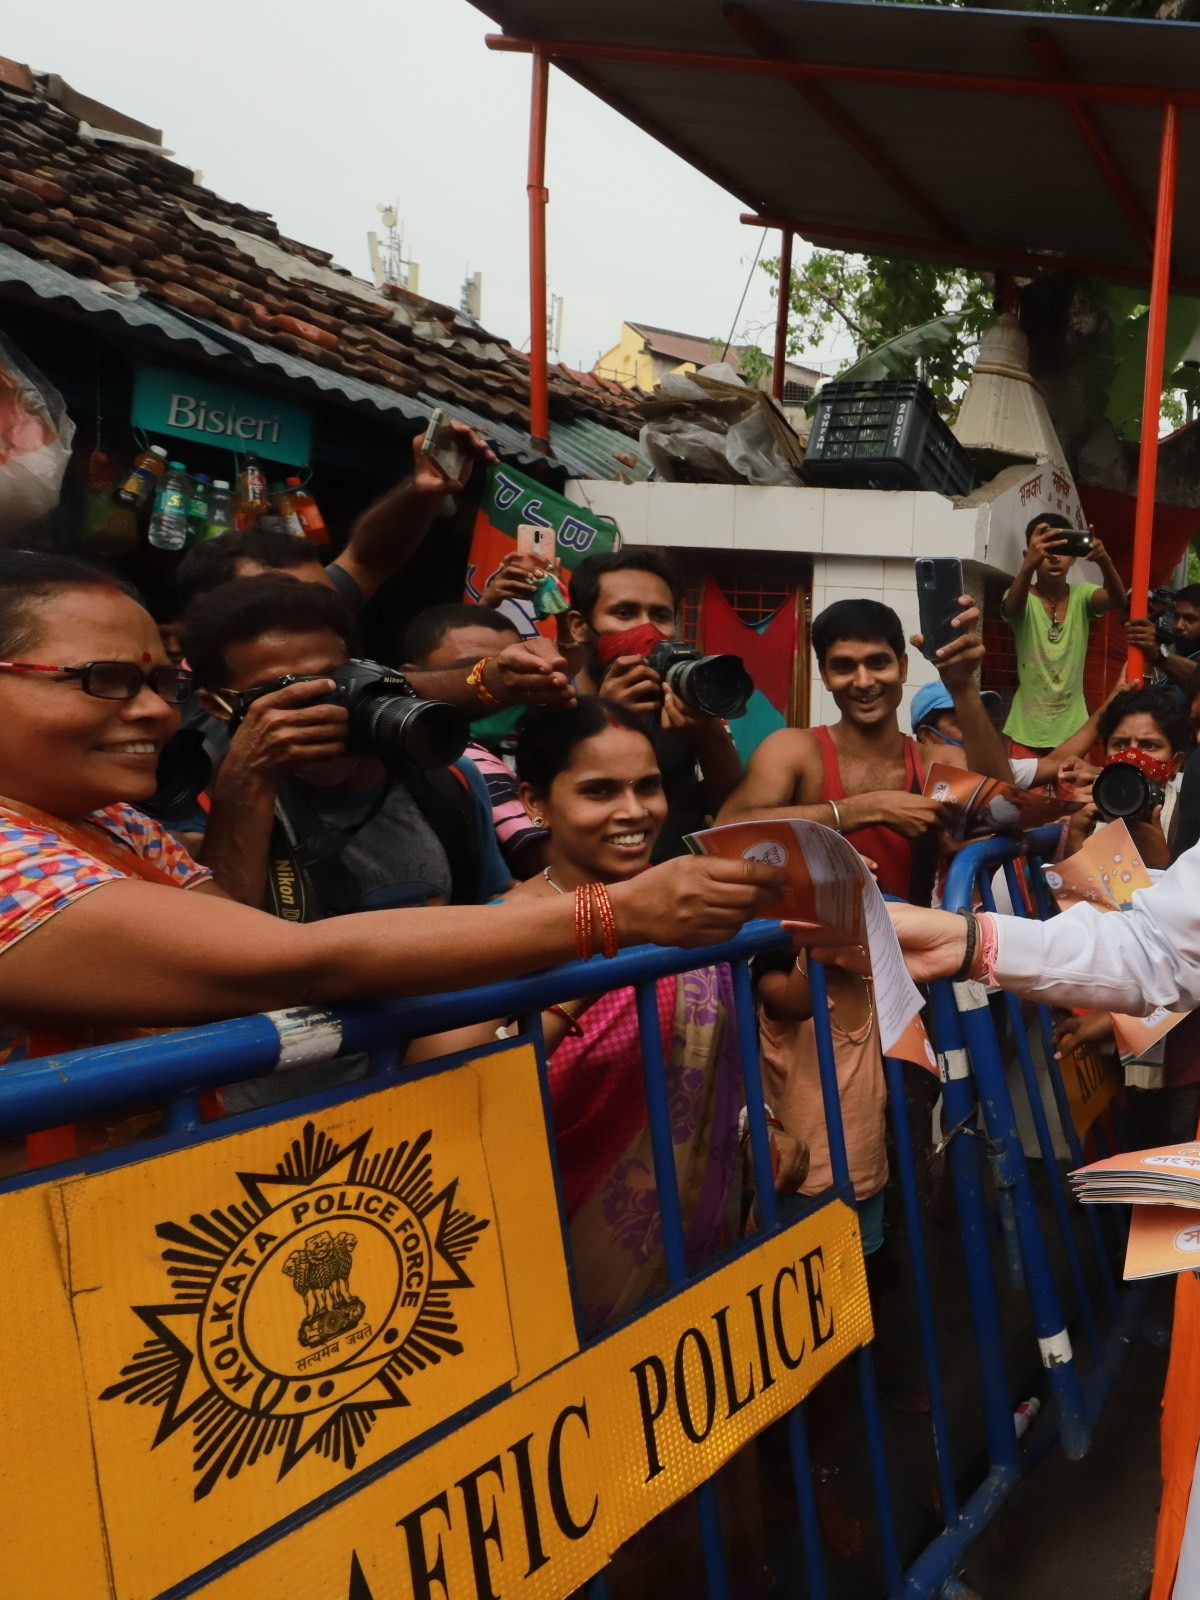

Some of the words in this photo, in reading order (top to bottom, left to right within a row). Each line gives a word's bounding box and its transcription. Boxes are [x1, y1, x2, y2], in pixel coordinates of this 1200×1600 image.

[166, 393, 281, 443] Bisleri
[816, 405, 832, 450] TOHFAH
[893, 403, 906, 447] 2021
[383, 676, 404, 684] Nikon
[275, 859, 295, 905] Nikon
[209, 1231, 279, 1393] KOLKATA
[291, 1191, 400, 1225] POLICE
[394, 1218, 424, 1308] FORCE
[344, 1322, 374, 1345] जयते
[629, 1245, 835, 1484] POLICE
